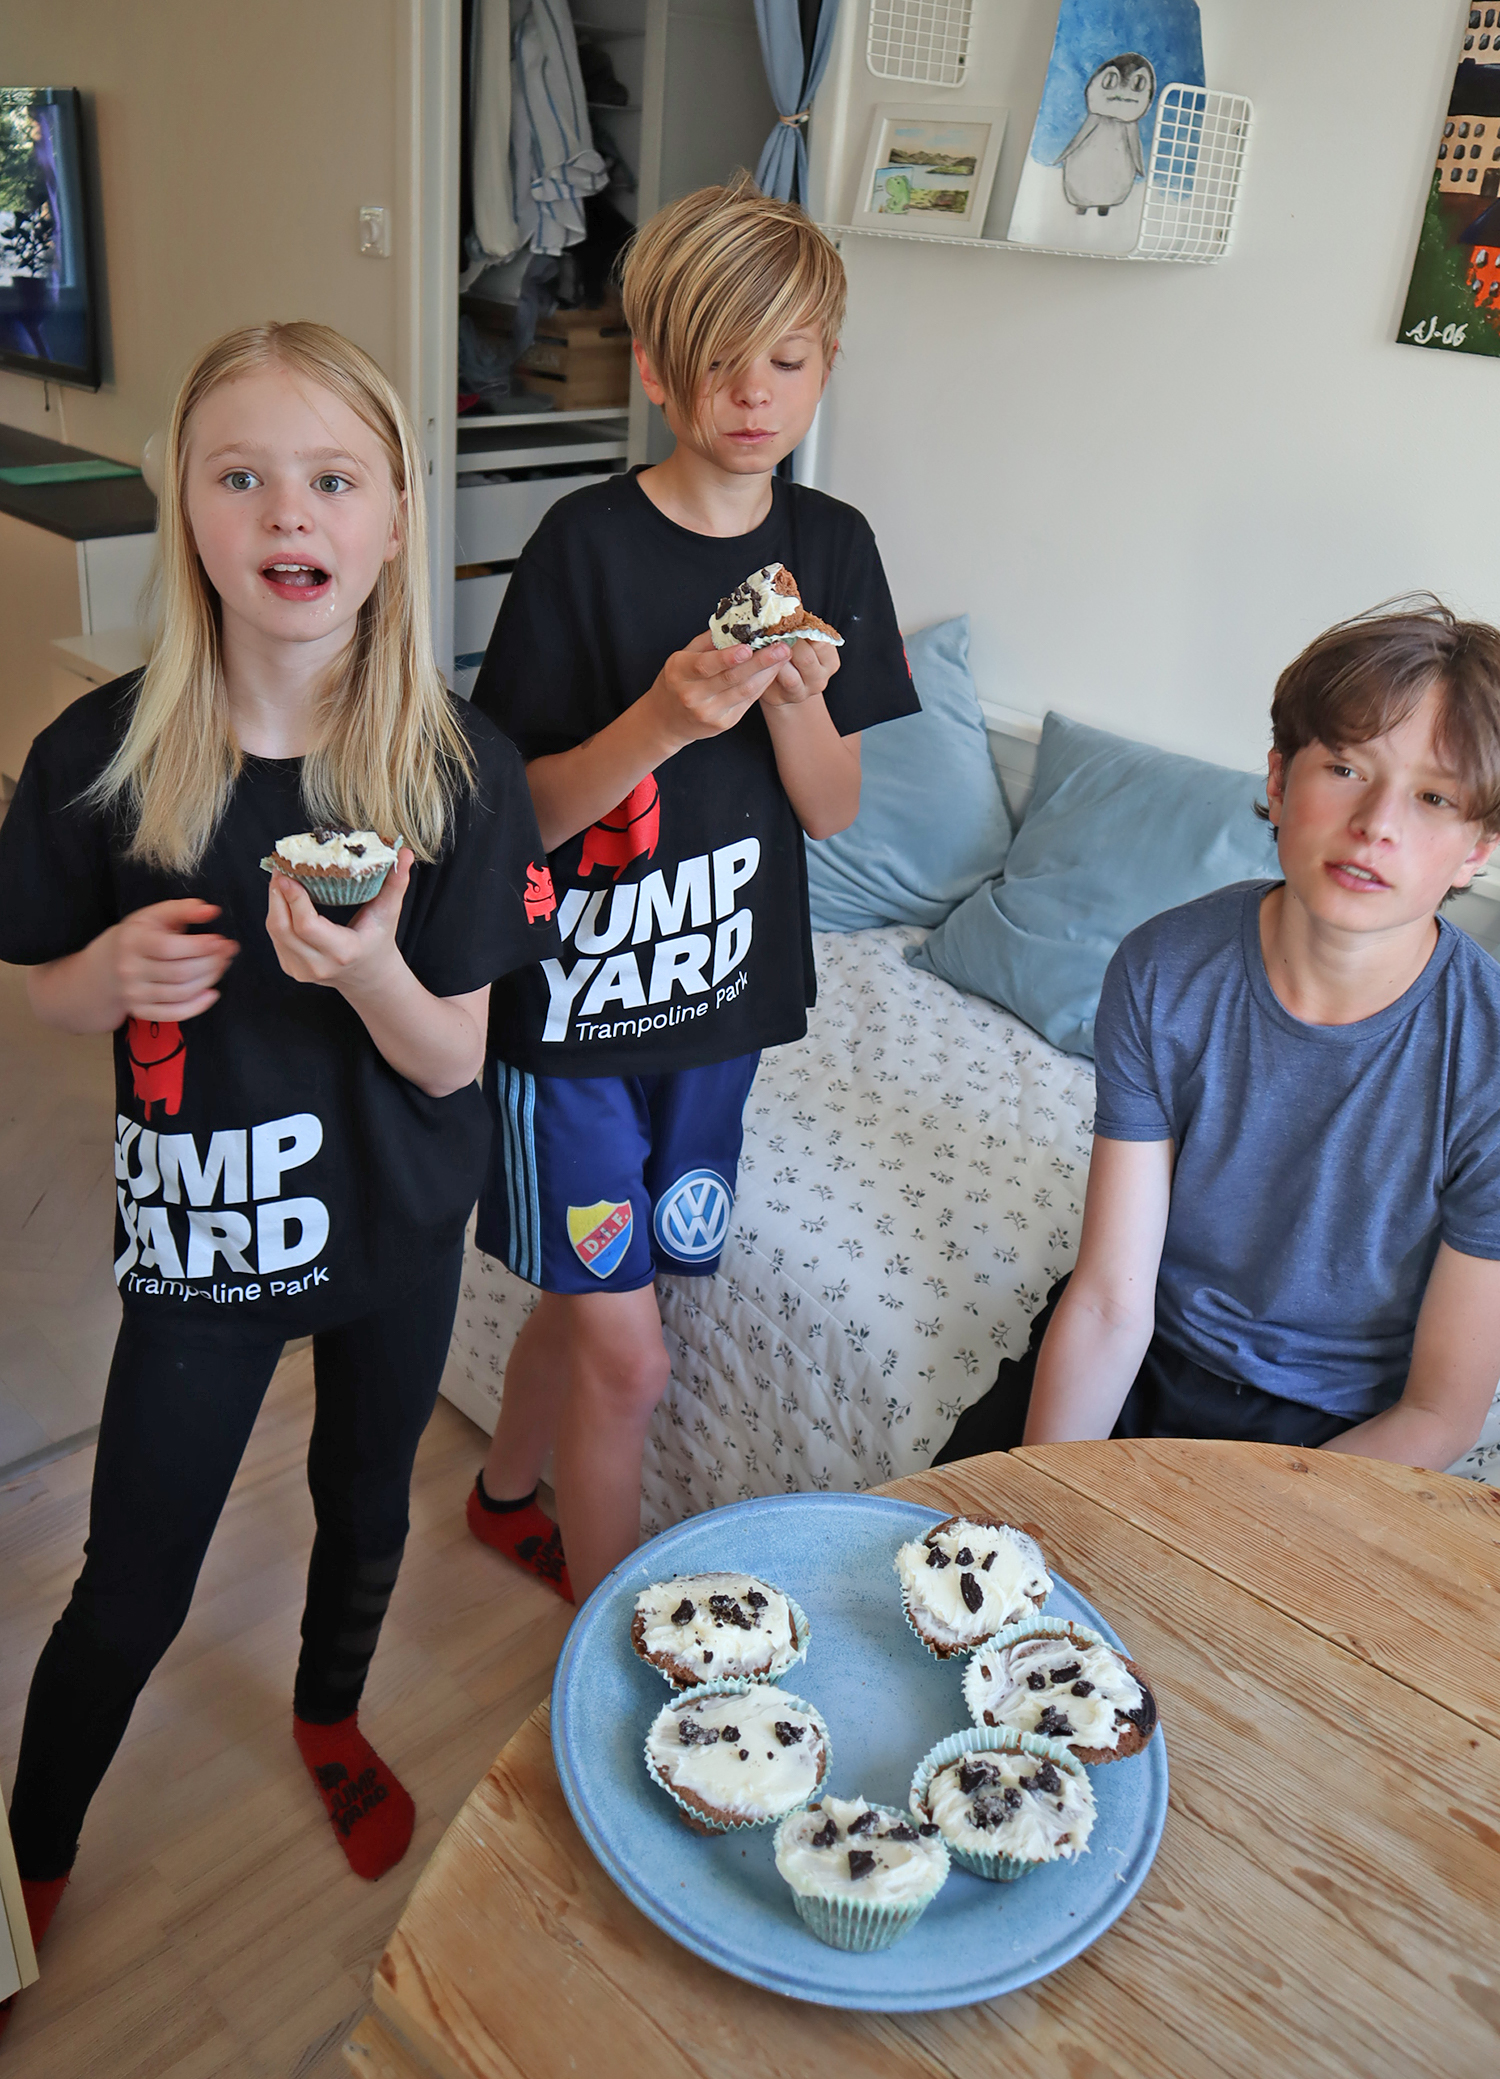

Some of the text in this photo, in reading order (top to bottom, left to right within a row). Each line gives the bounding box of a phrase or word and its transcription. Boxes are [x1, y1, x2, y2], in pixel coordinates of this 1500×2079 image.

[539, 907, 753, 1042] YARD
[575, 970, 749, 1042] Trampoline Park
[113, 1185, 331, 1287] YARD
[269, 1266, 330, 1297] Park
